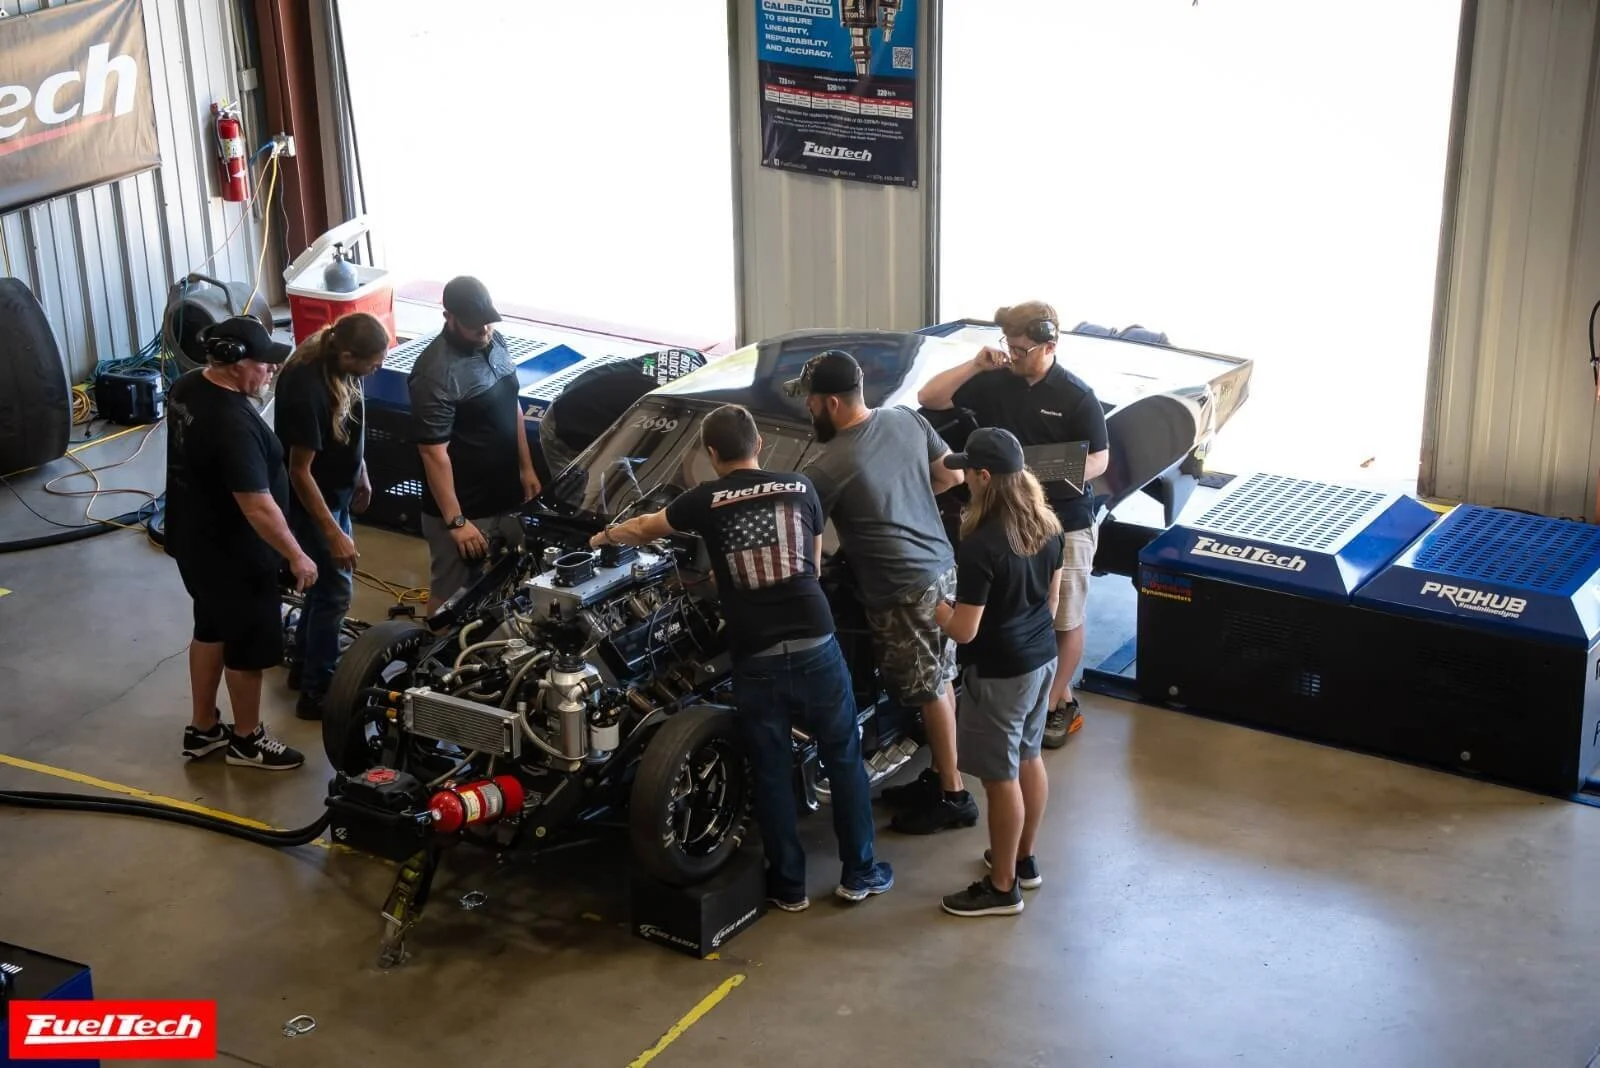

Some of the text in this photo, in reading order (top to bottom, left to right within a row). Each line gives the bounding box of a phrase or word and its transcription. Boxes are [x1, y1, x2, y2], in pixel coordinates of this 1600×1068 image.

[763, 1, 831, 16] CALIBRATED
[764, 13, 813, 26] TO ENSURE
[765, 24, 809, 36] LINEARITY,
[766, 33, 828, 47] REPEATABILITY
[766, 43, 833, 58] AND ACCURACY.
[803, 141, 873, 162] FuelTech
[712, 481, 807, 504] FuelTech
[1191, 536, 1307, 572] FuelTech
[1420, 581, 1527, 613] PROHUB
